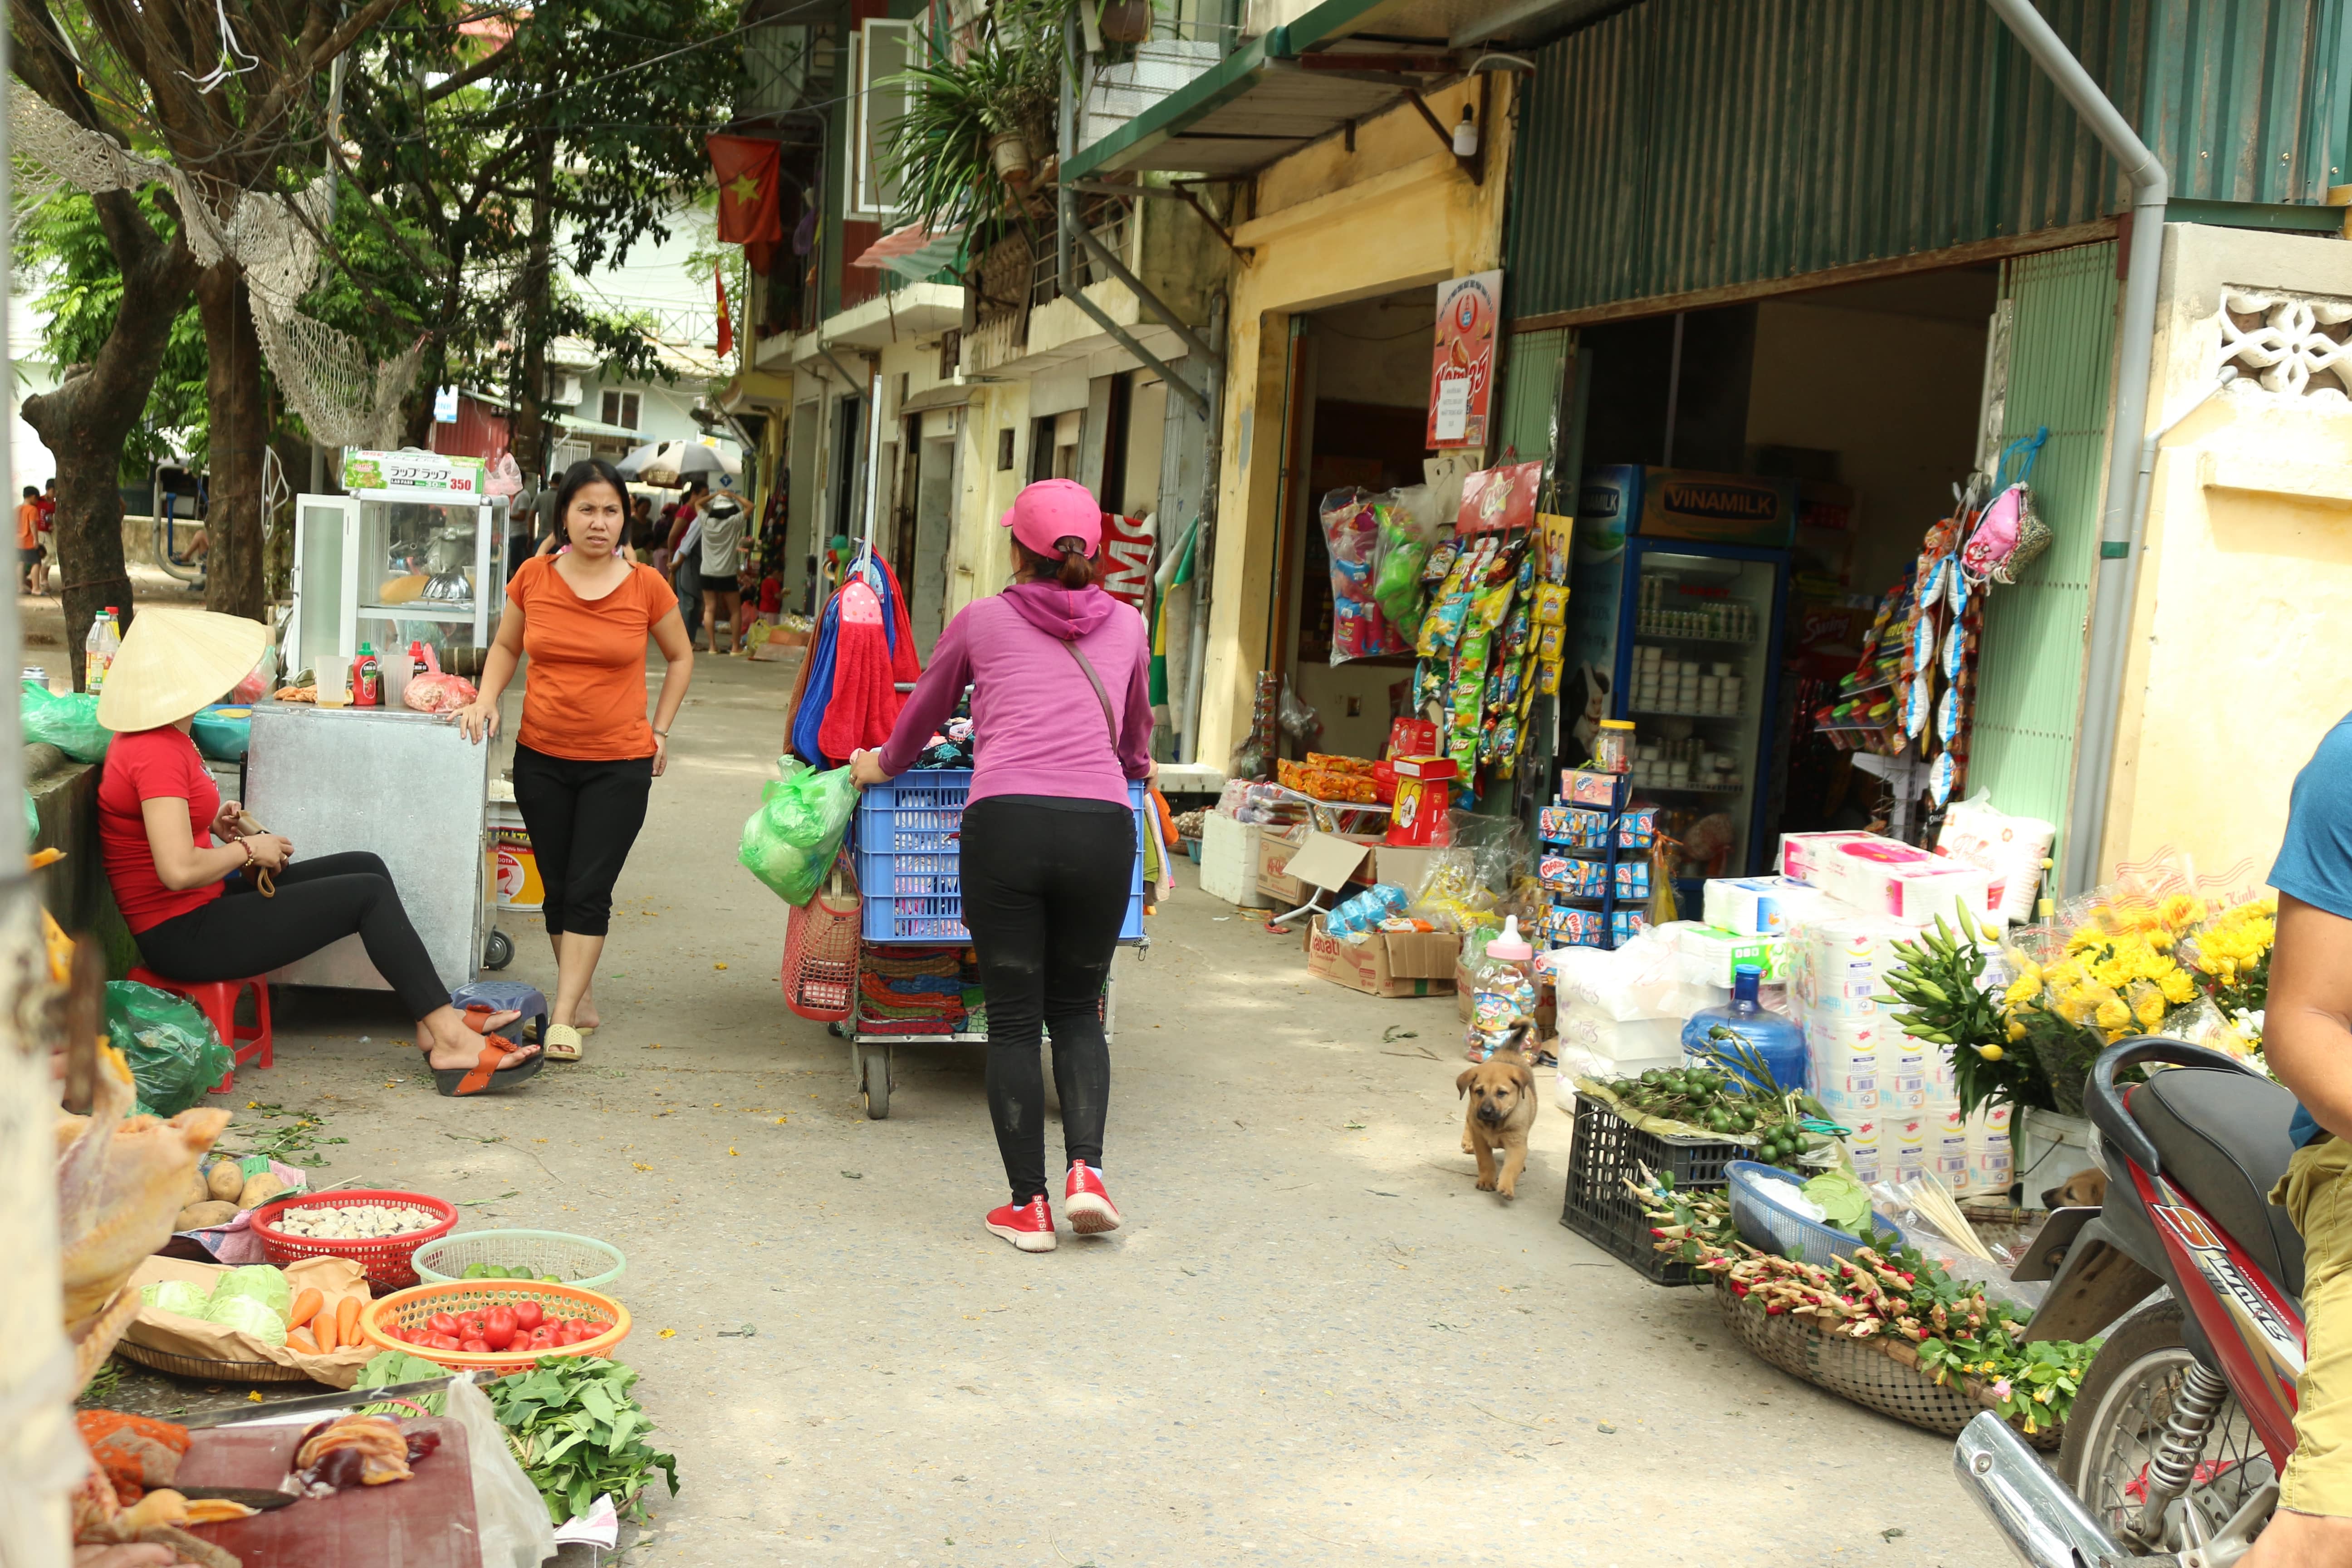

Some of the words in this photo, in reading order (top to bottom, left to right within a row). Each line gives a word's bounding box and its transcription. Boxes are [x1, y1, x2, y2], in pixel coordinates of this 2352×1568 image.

[450, 478, 471, 490] 350
[1581, 493, 1617, 512] NAMILK
[1670, 487, 1770, 514] VINAMILK
[1801, 615, 1850, 644] Swing
[1543, 860, 1567, 877] MARINE
[2239, 1265, 2268, 1299] SPLENDID
[2266, 1299, 2291, 1326] MOVER
